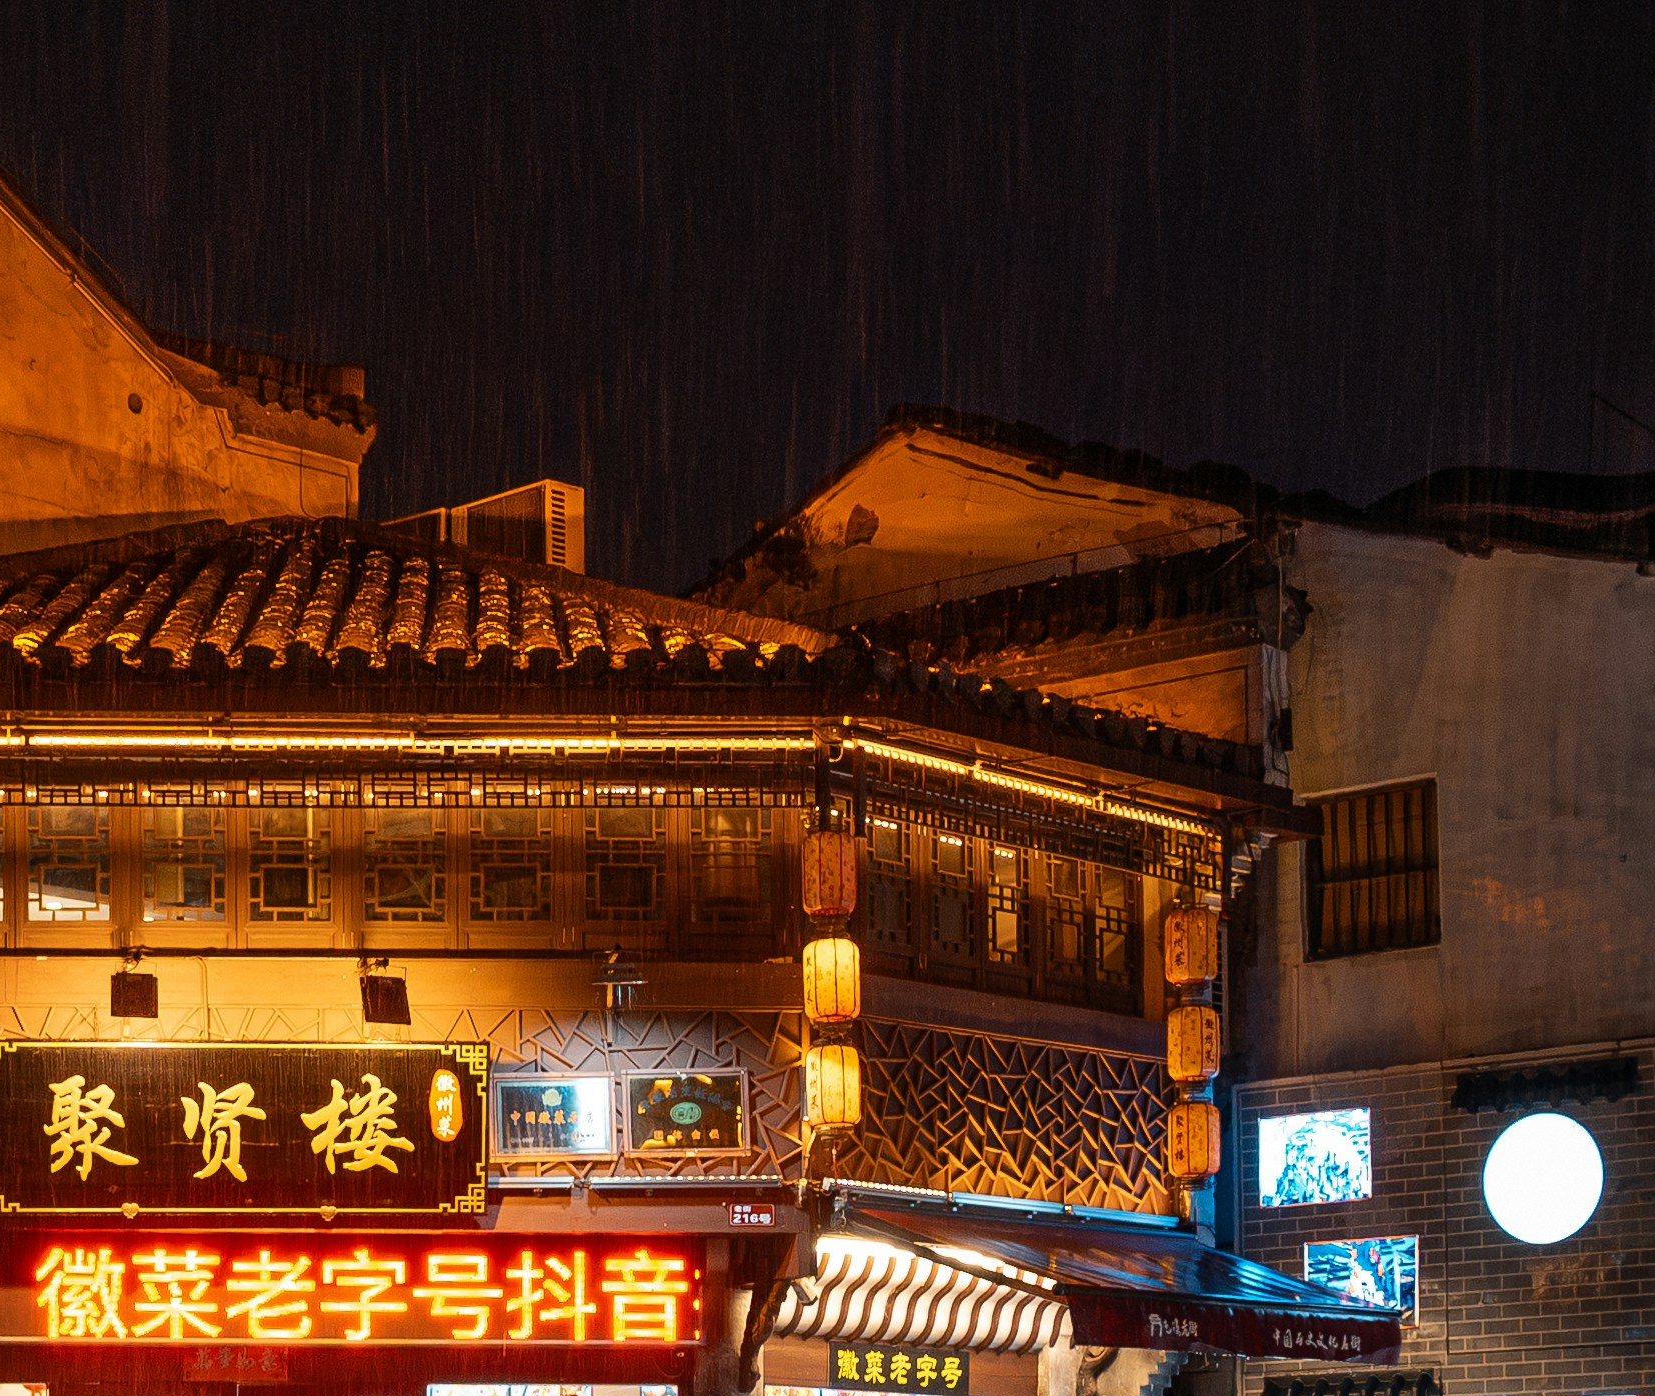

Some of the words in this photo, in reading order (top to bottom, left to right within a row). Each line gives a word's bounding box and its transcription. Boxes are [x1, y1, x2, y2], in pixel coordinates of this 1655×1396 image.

[43, 1073, 417, 1183] 聚贤楼
[436, 1073, 460, 1140] 徽州菜
[732, 1213, 772, 1225] 216号
[33, 1246, 701, 1343] 徽菜老字号抖音
[836, 1349, 963, 1389] 徽菜老字号
